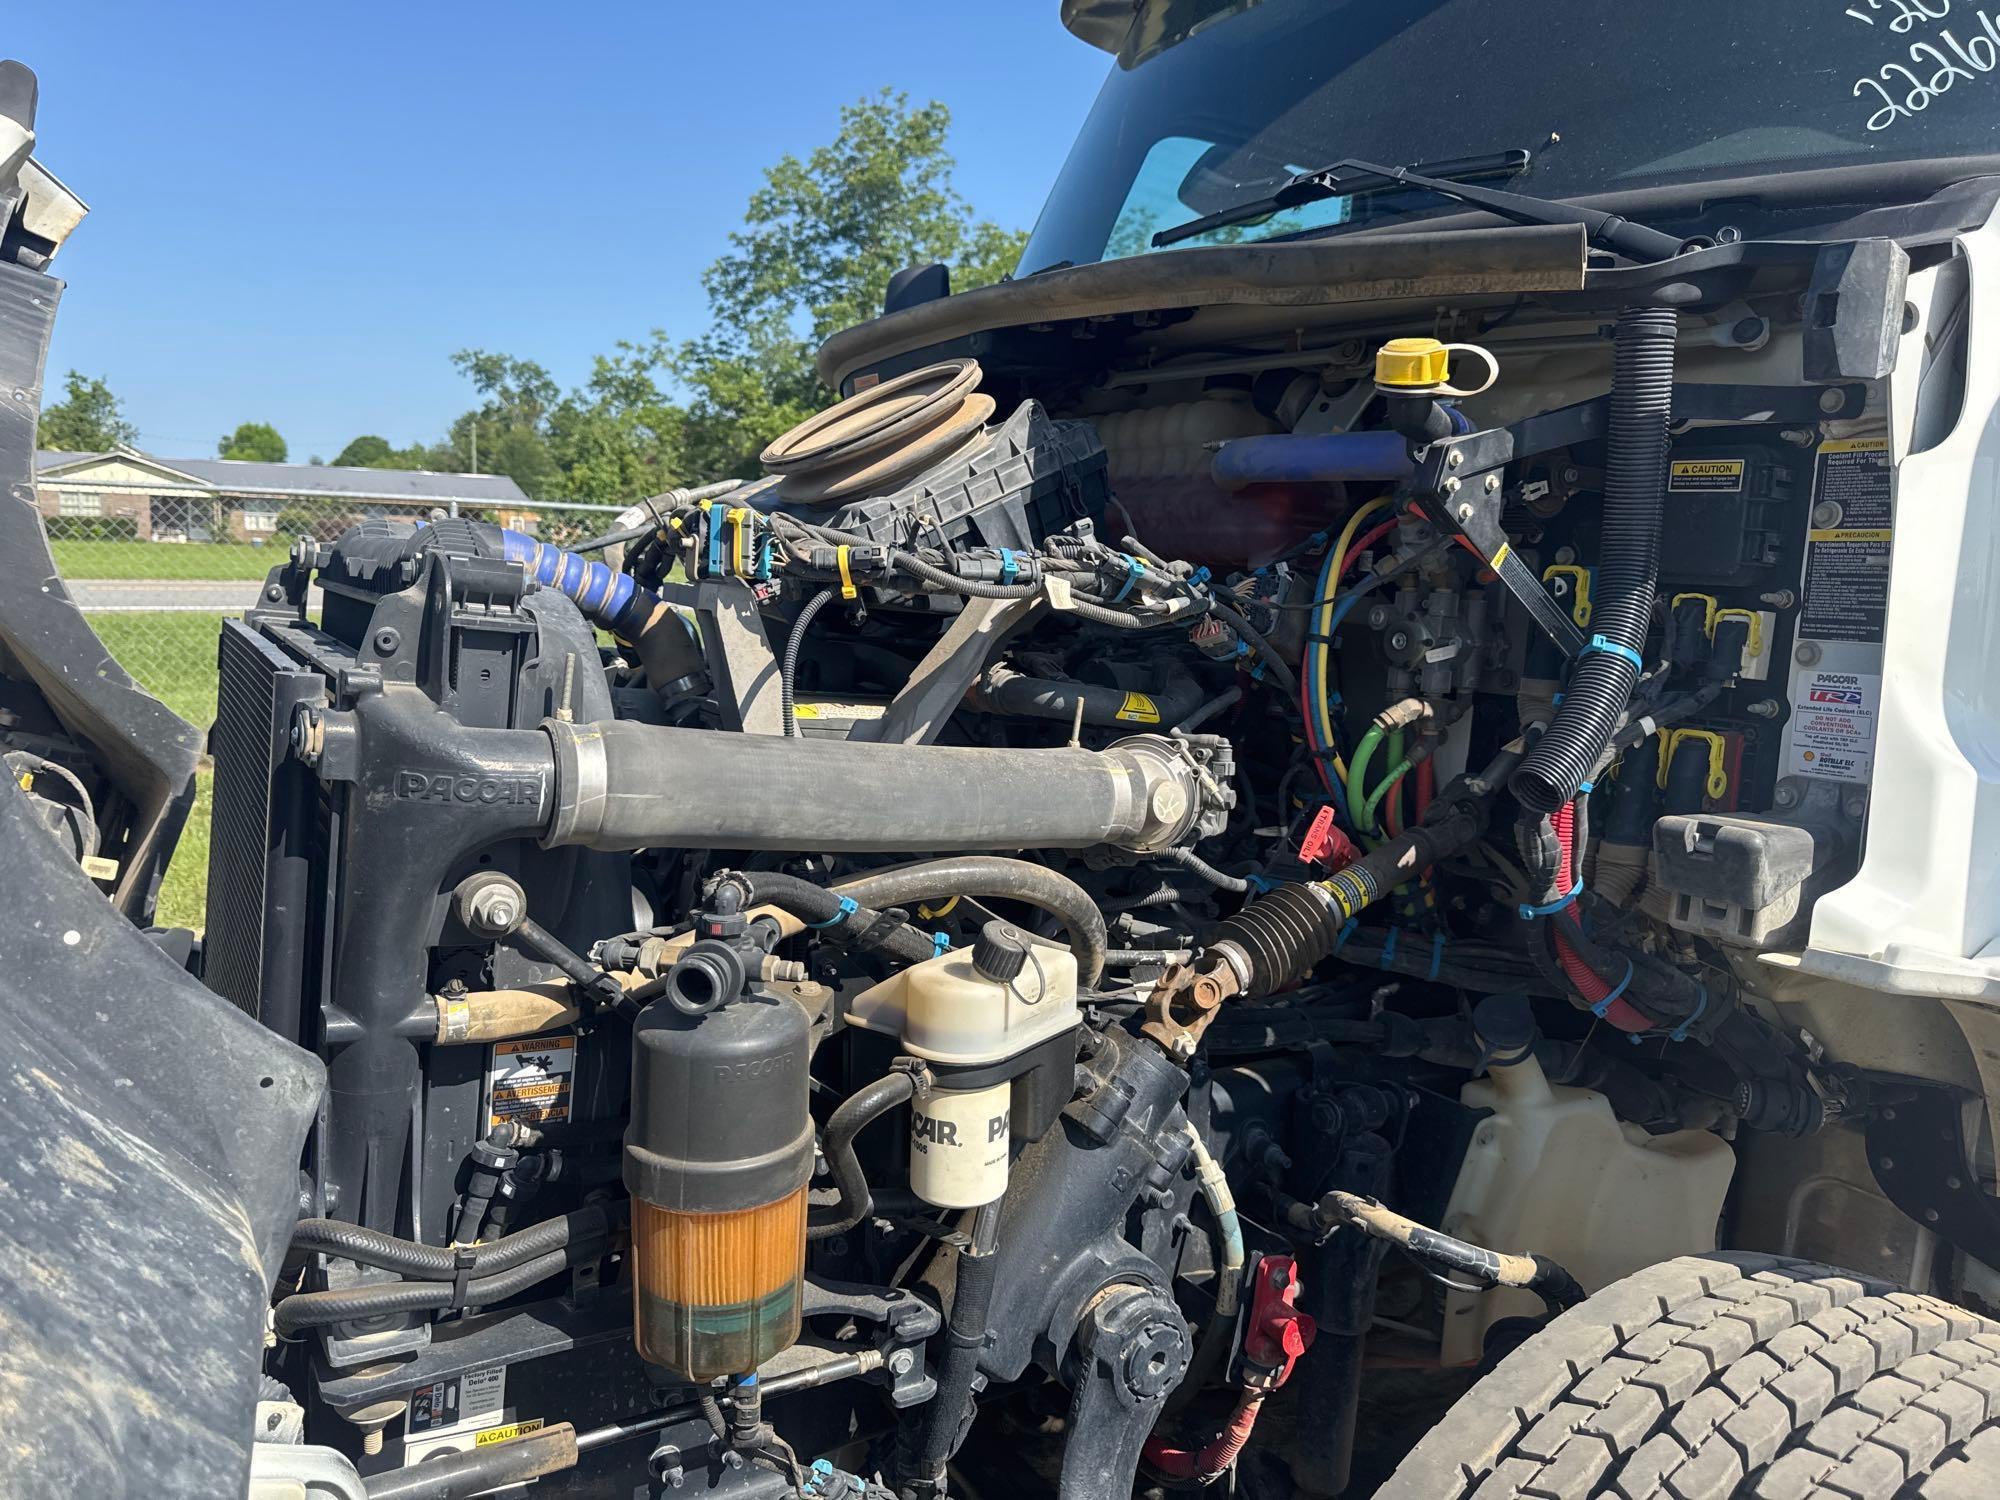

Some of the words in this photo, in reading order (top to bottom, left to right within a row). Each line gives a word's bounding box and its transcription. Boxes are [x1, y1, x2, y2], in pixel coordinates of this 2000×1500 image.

[1692, 465, 1733, 473] CAUTION
[1817, 674, 1858, 685] PACCAR
[1812, 690, 1862, 704] TRP
[1811, 720, 1855, 729] CONVENTIONAL
[399, 771, 541, 805] PACCAR
[1311, 815, 1329, 840] TRANS
[1303, 840, 1314, 854] OIL
[522, 1040, 560, 1051] WARNING
[506, 1084, 570, 1098] AVERTISSEMENT
[464, 1371, 485, 1379] Factory
[434, 1392, 442, 1408] Delo
[487, 1423, 541, 1441] CAUTION
